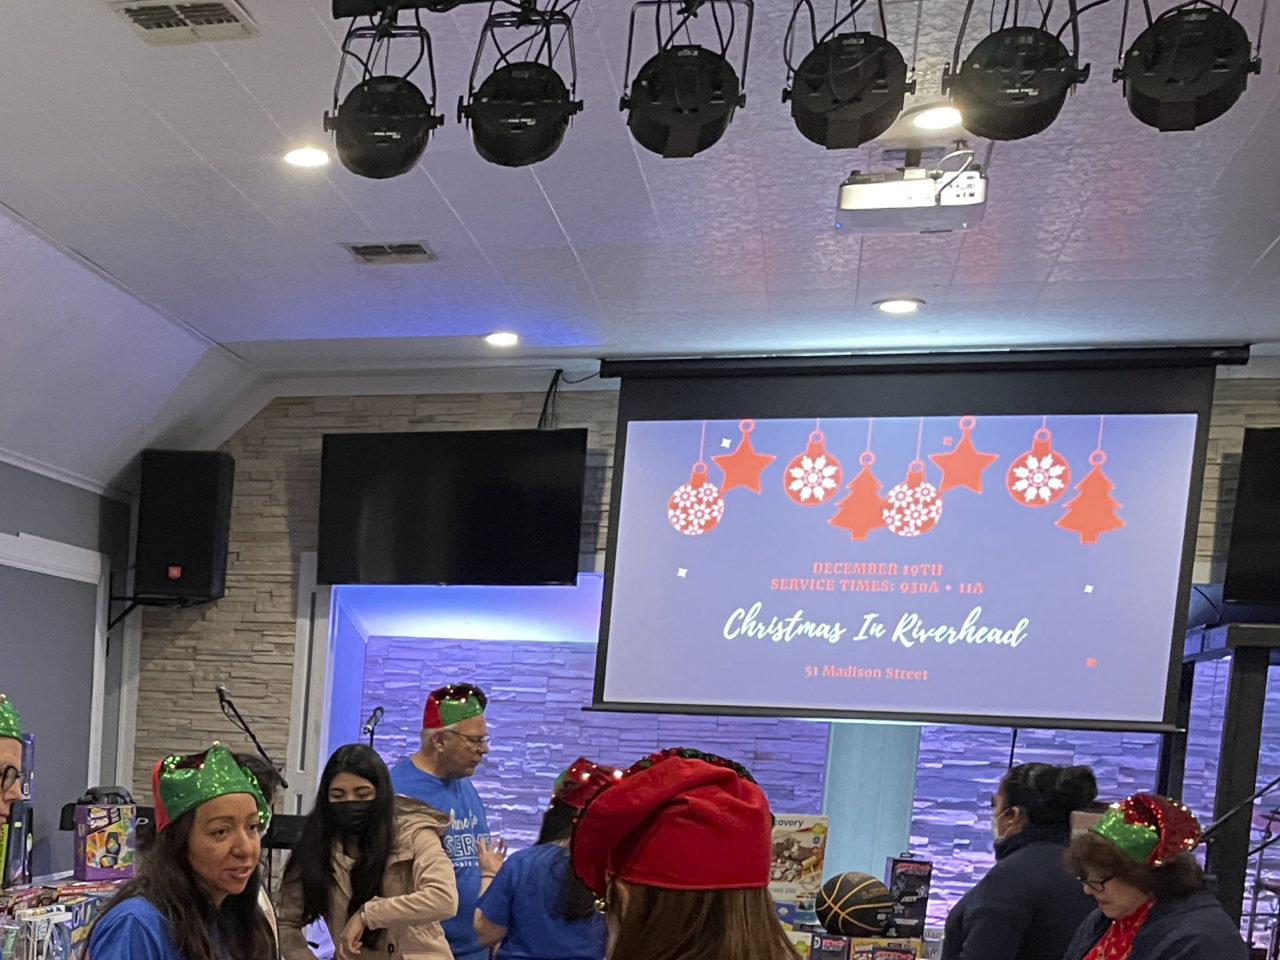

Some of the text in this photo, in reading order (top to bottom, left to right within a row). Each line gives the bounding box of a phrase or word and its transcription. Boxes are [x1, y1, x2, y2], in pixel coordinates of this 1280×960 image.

[812, 562, 943, 577] DECEMBER 19TH
[770, 578, 984, 594] SERVICE TIMES: 930A 11A
[723, 601, 1030, 648] Christmas In Riverhead
[804, 664, 929, 681] 51 Madison Street
[774, 819, 804, 828] covery
